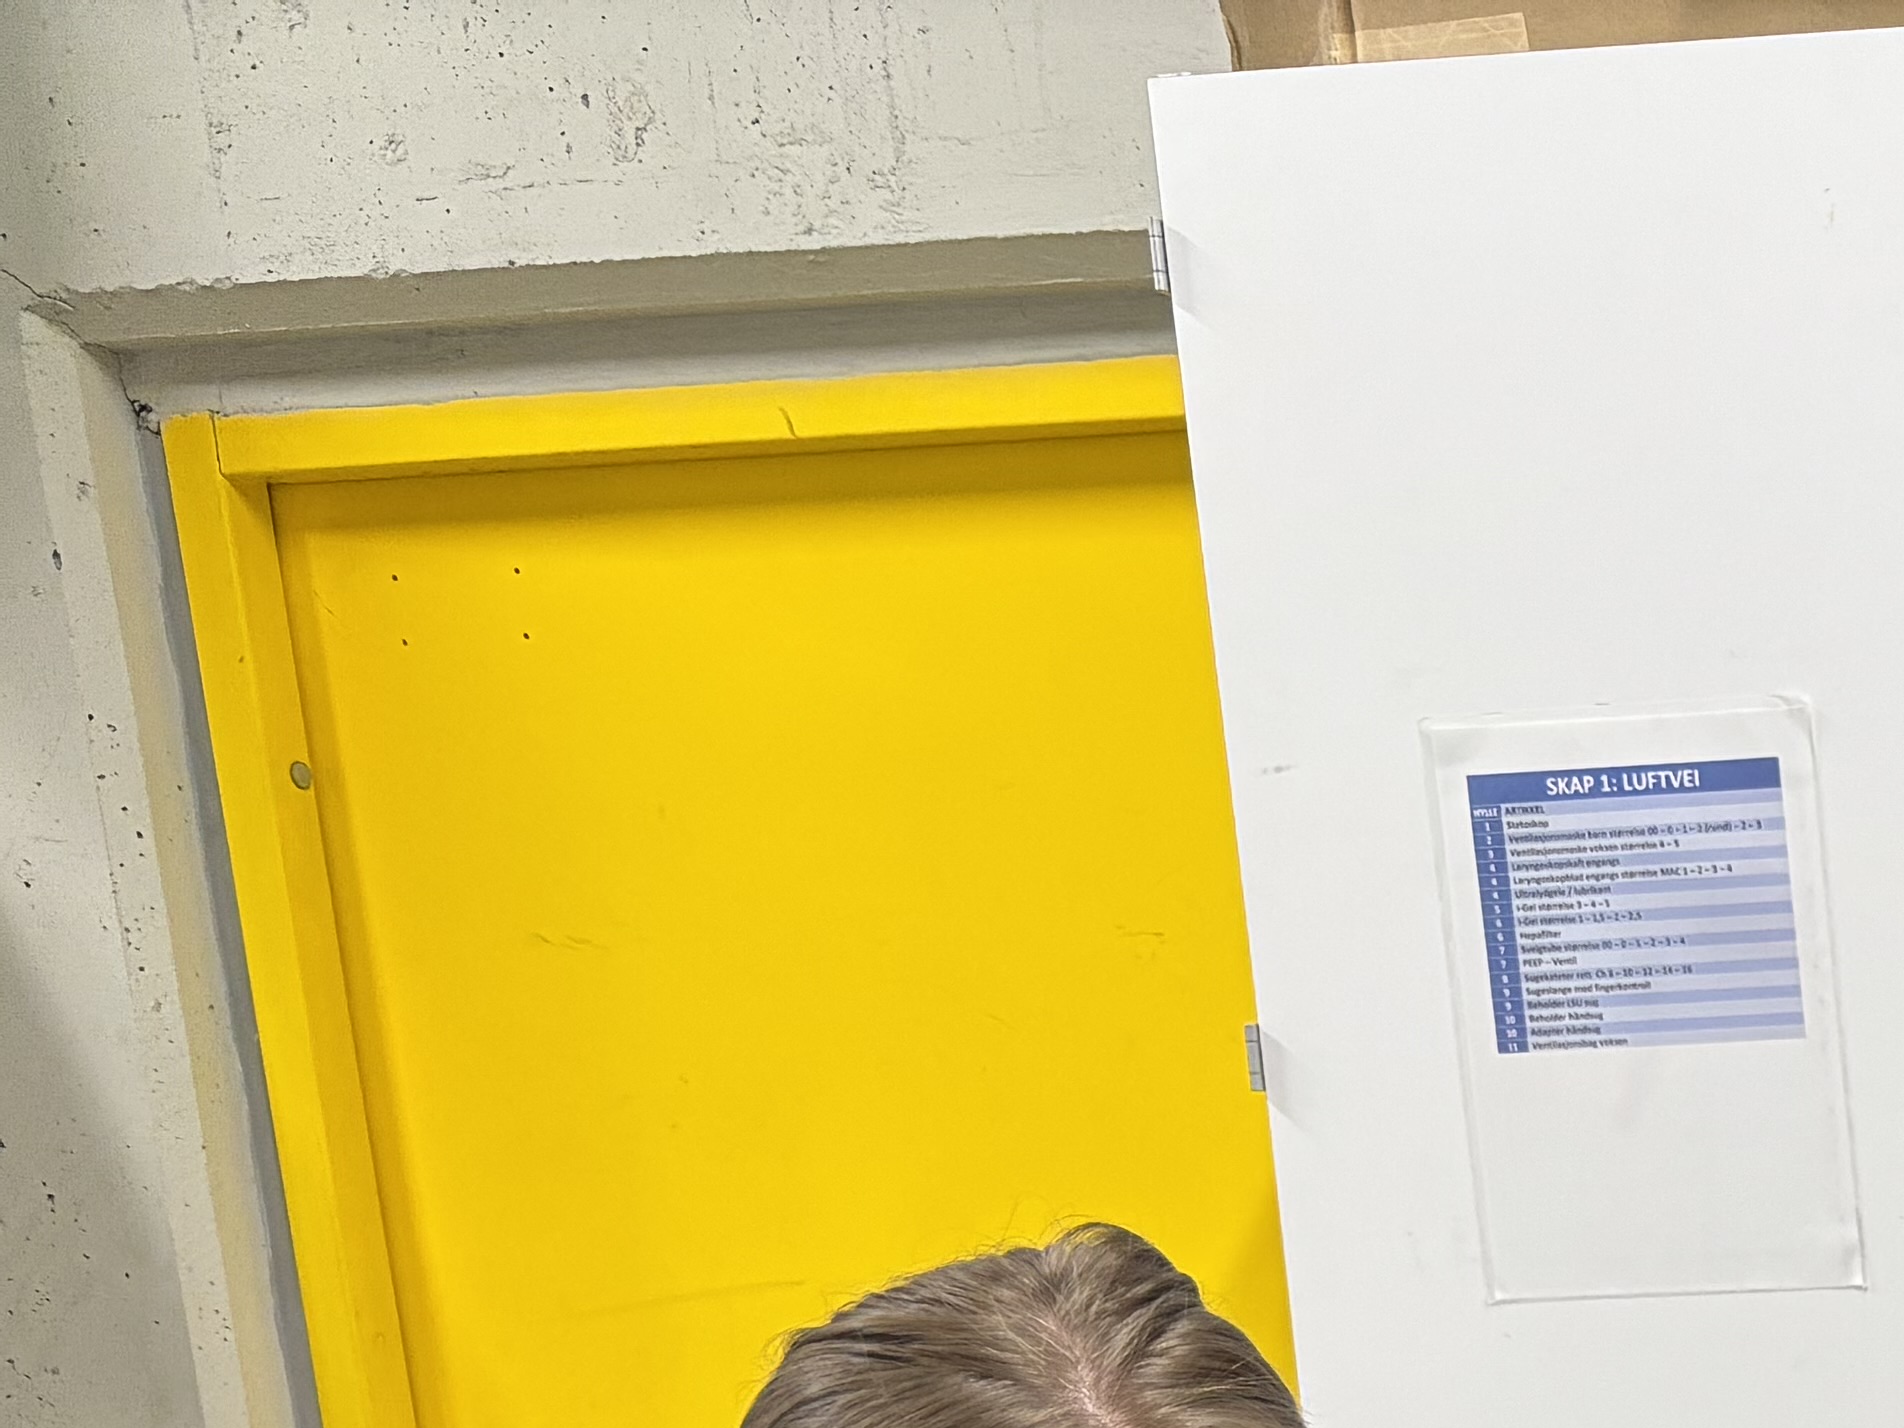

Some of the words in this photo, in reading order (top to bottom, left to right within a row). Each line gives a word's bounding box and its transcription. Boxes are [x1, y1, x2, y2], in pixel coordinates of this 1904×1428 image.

[1544, 774, 1596, 796] SKAP
[1599, 773, 1618, 792] 1:
[1621, 768, 1701, 792] LUFTVEI
